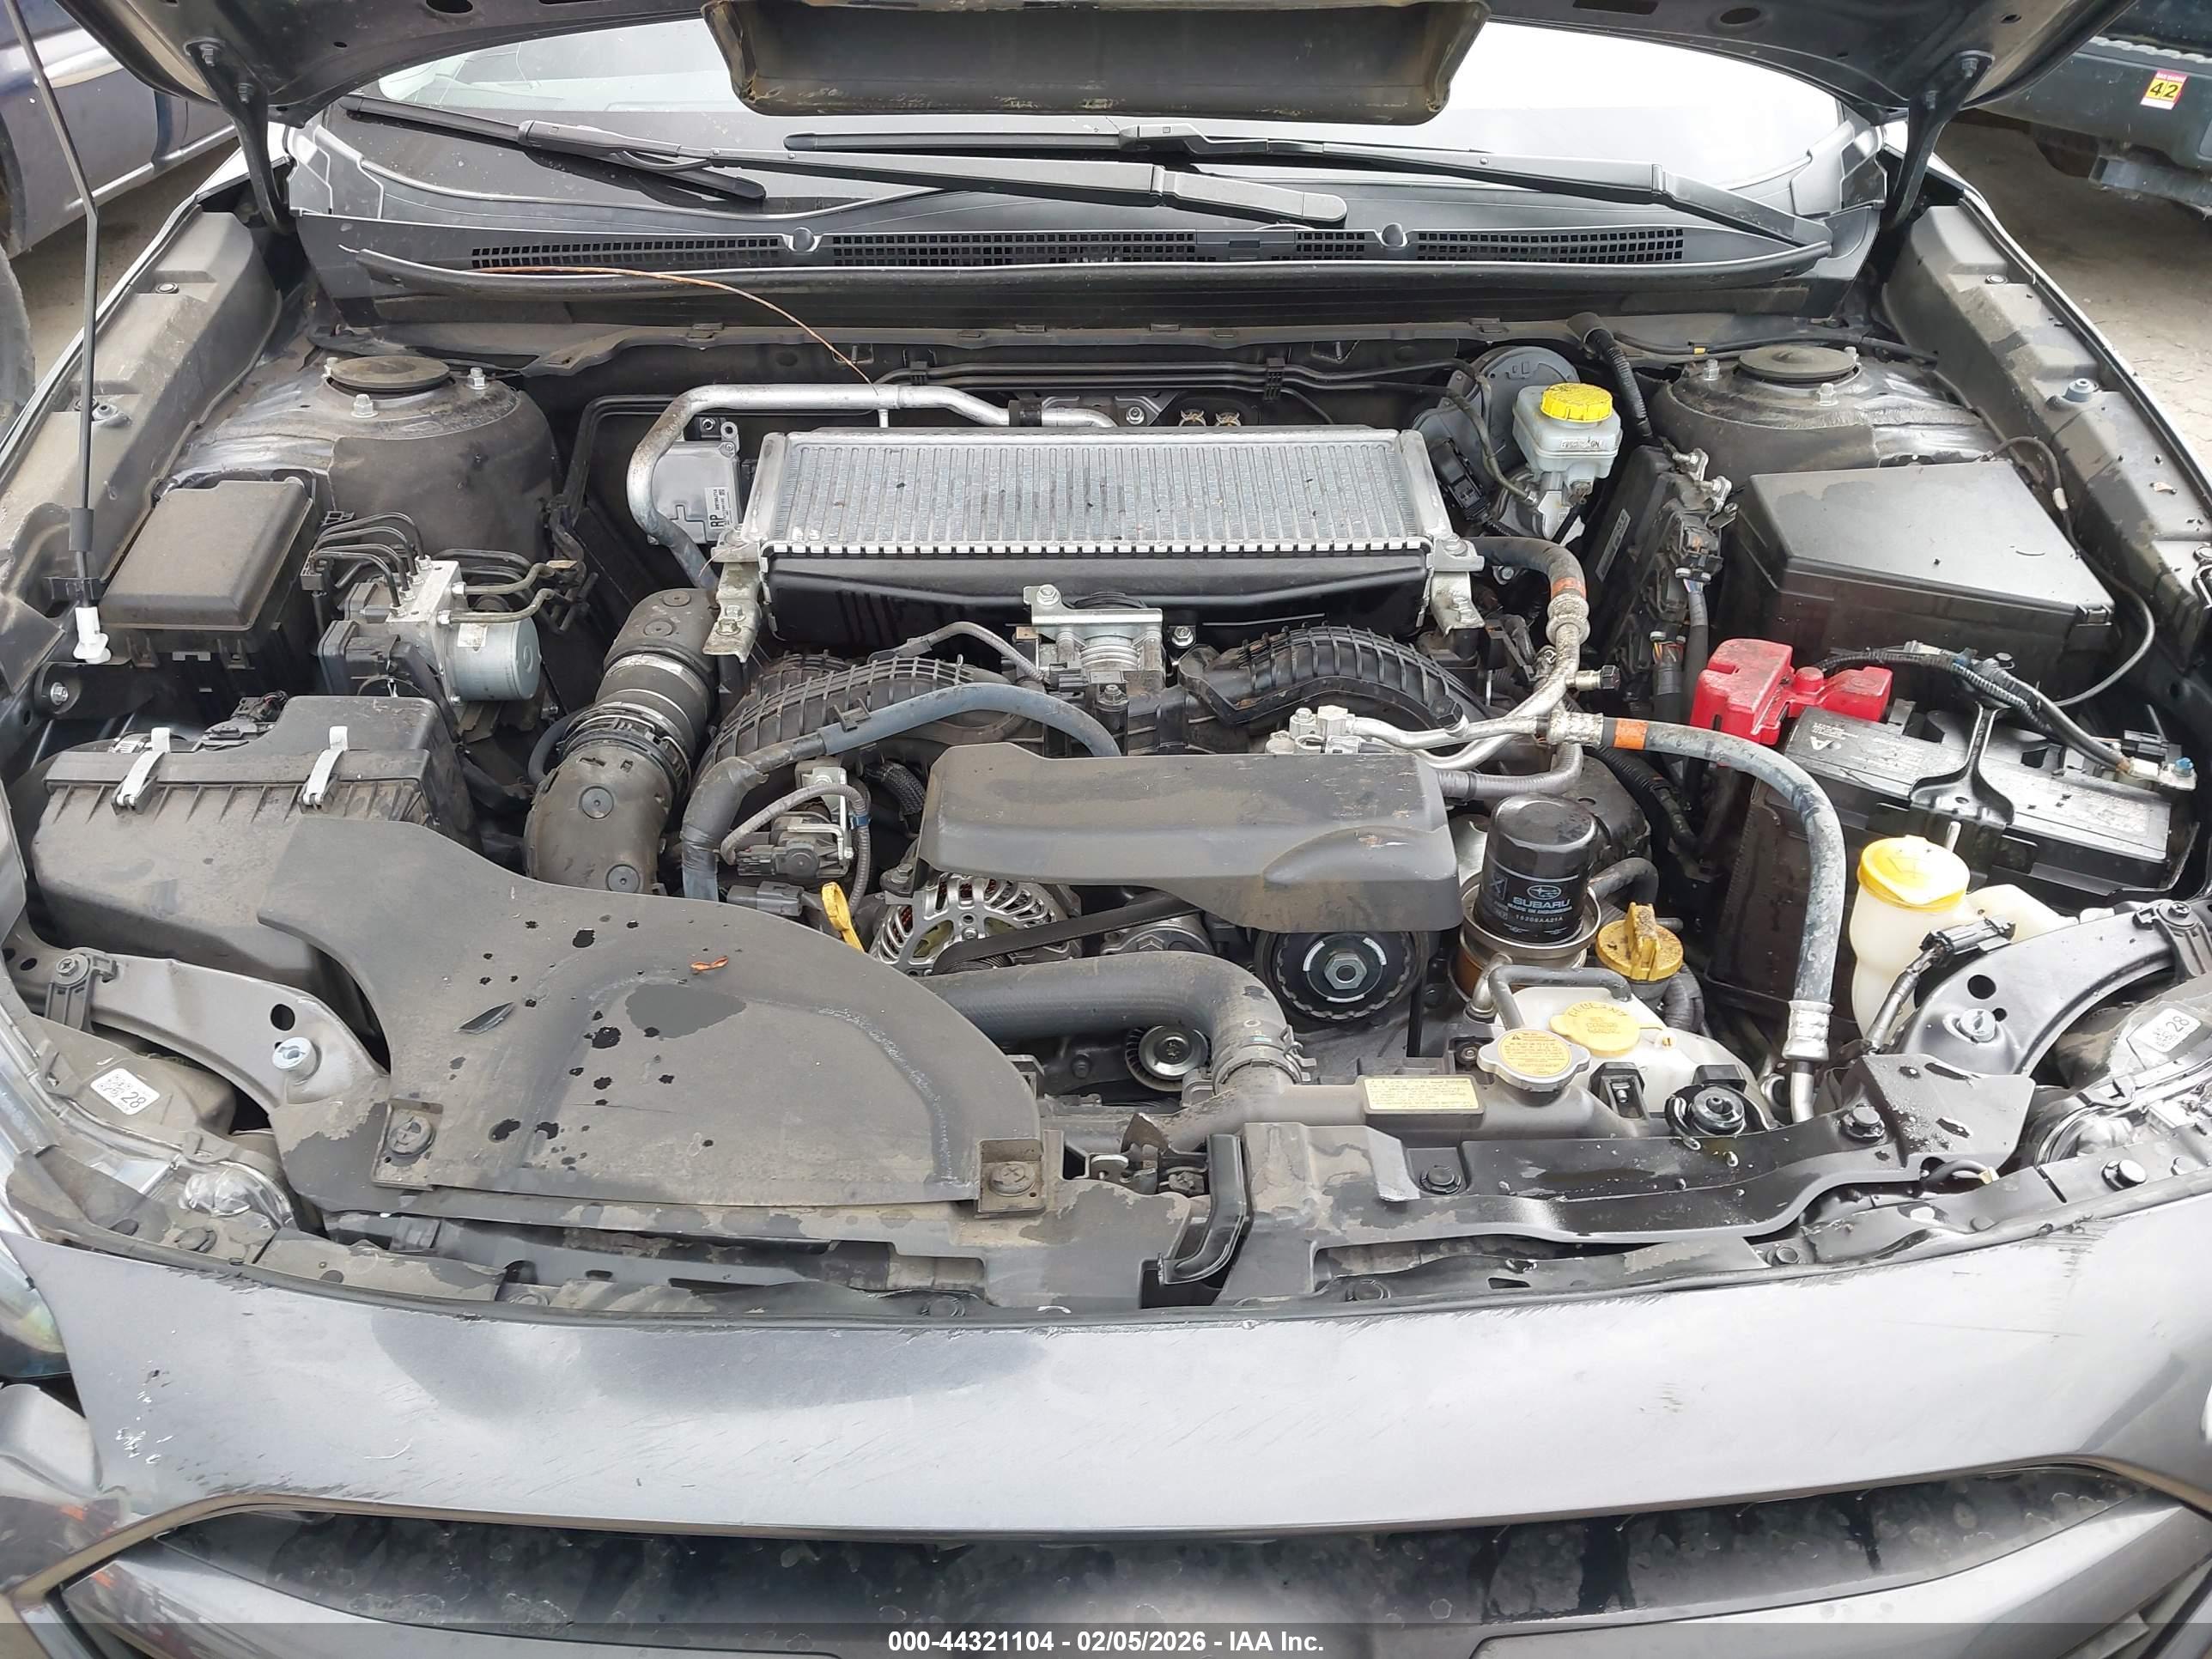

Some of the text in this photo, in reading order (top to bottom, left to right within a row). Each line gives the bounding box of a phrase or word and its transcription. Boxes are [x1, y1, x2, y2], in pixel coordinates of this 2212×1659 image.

[2149, 82, 2179, 99] 42
[1512, 896, 1571, 908] SUBARU
[2166, 1016, 2190, 1032] 28
[120, 1091, 147, 1109] 28
